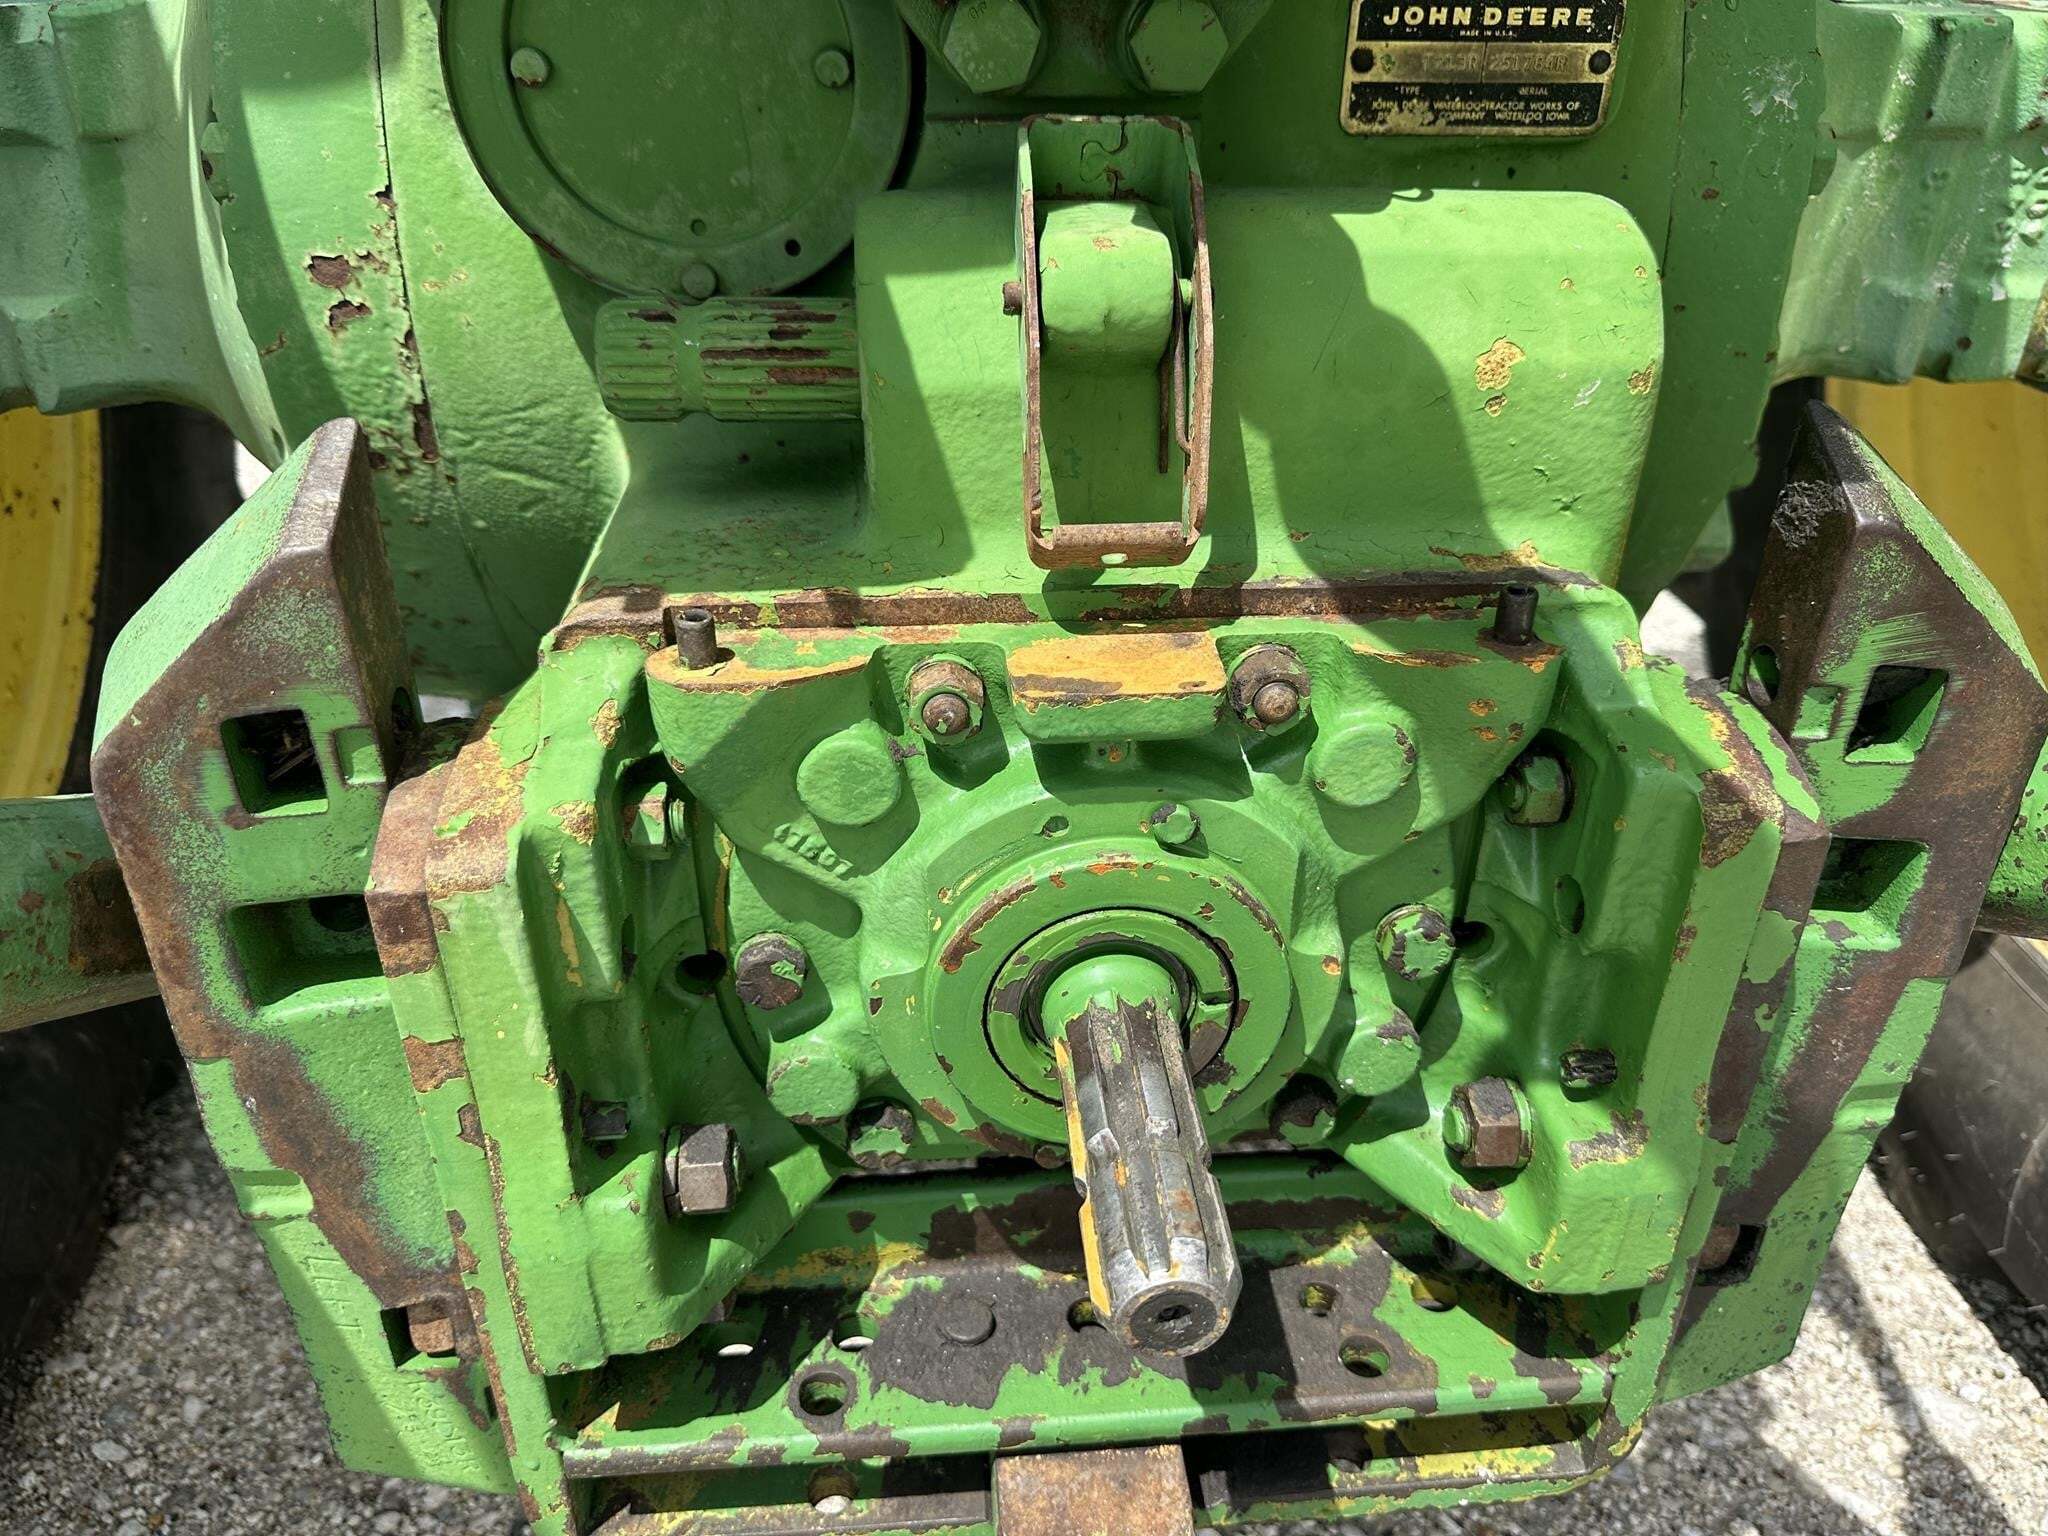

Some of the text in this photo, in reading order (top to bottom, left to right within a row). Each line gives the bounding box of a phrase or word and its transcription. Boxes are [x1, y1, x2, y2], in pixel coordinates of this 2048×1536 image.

[1383, 6, 1594, 27] JOHN DEERE
[1460, 29, 1479, 37] MADE
[1400, 86, 1420, 95] TYPE
[1520, 86, 1548, 96] SERIAL
[1530, 101, 1562, 111] WORKS
[1566, 101, 1580, 111] OF
[1546, 111, 1570, 121] IOWA
